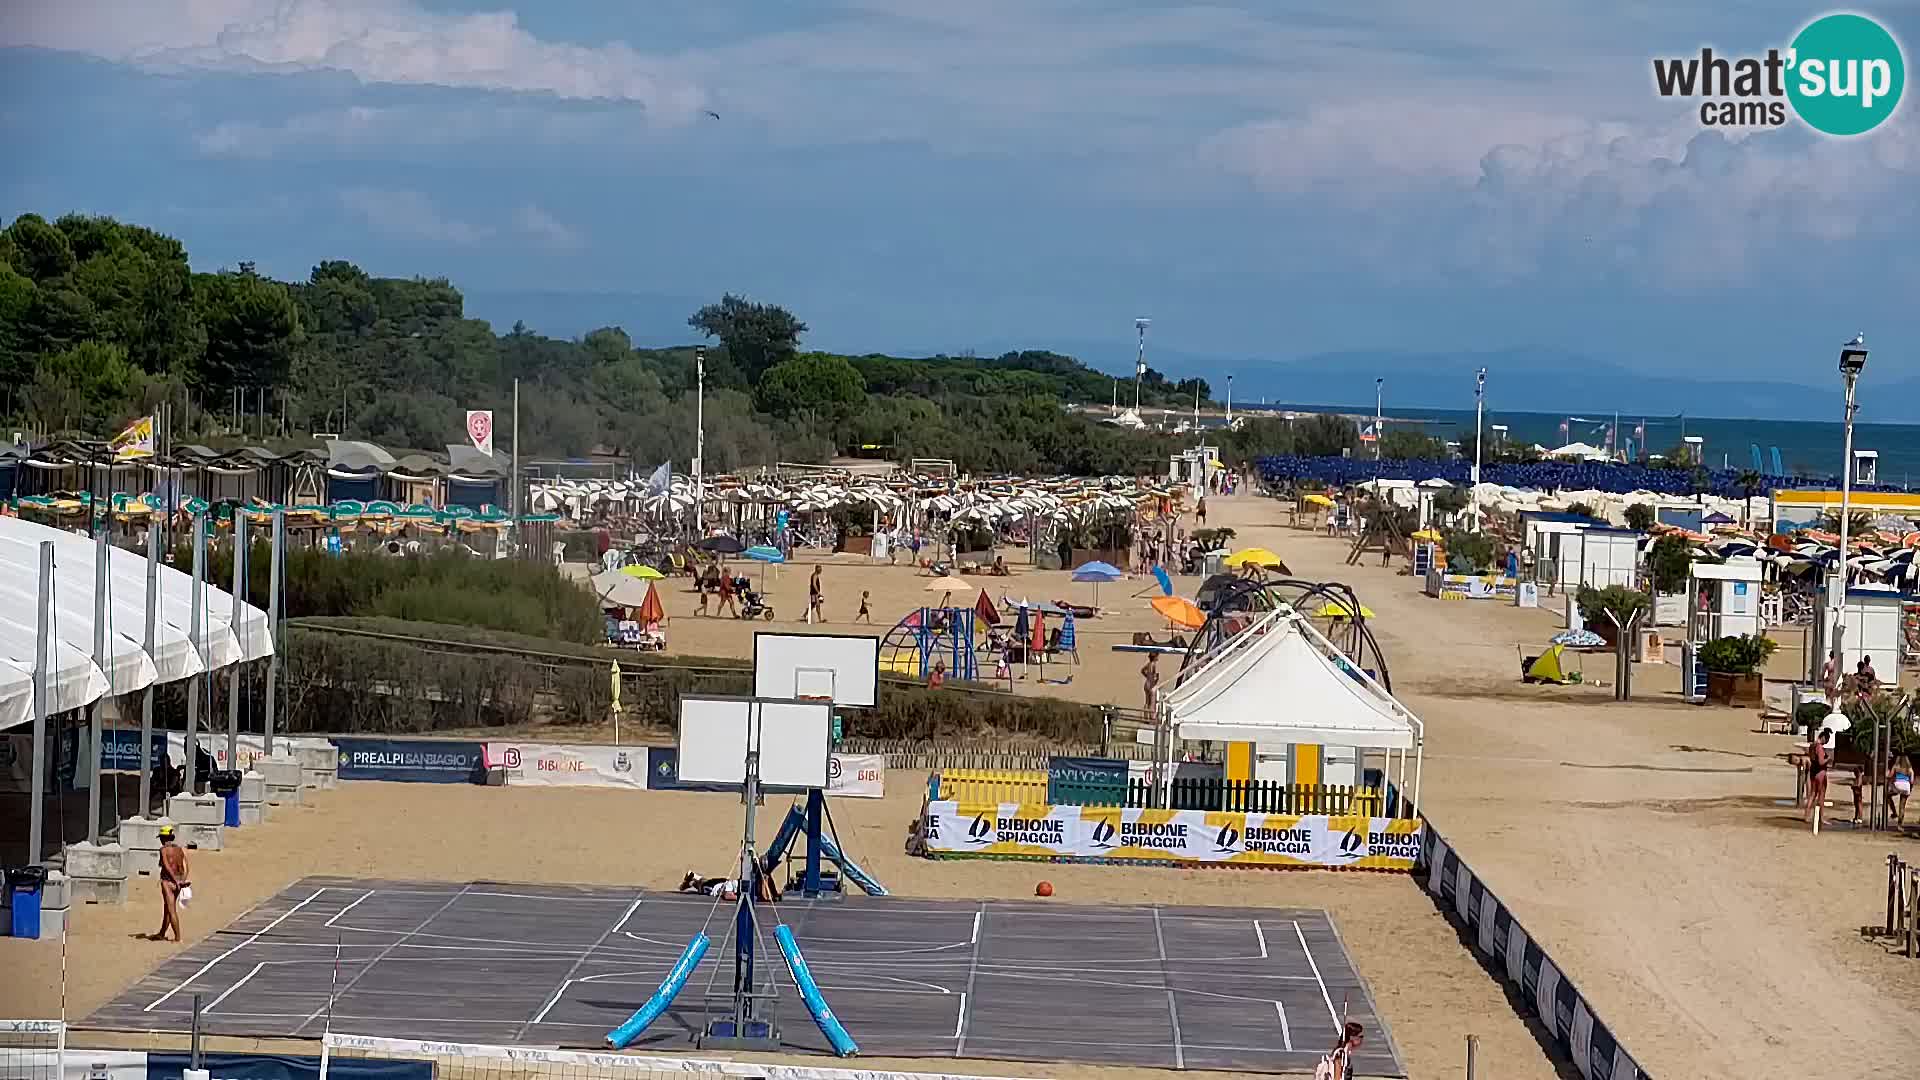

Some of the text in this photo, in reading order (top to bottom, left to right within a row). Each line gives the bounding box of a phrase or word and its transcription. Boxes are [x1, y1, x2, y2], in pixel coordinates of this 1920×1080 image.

[353, 751, 404, 764] PREALPI
[996, 817, 1064, 832] BIBIONE
[1121, 822, 1188, 837] BIBIONE
[996, 831, 1063, 844] SPIAGGIA
[1245, 827, 1312, 842] BIBIONE
[1120, 835, 1187, 849] SPIAGGIA
[1244, 840, 1311, 853] SPIAGGIA
